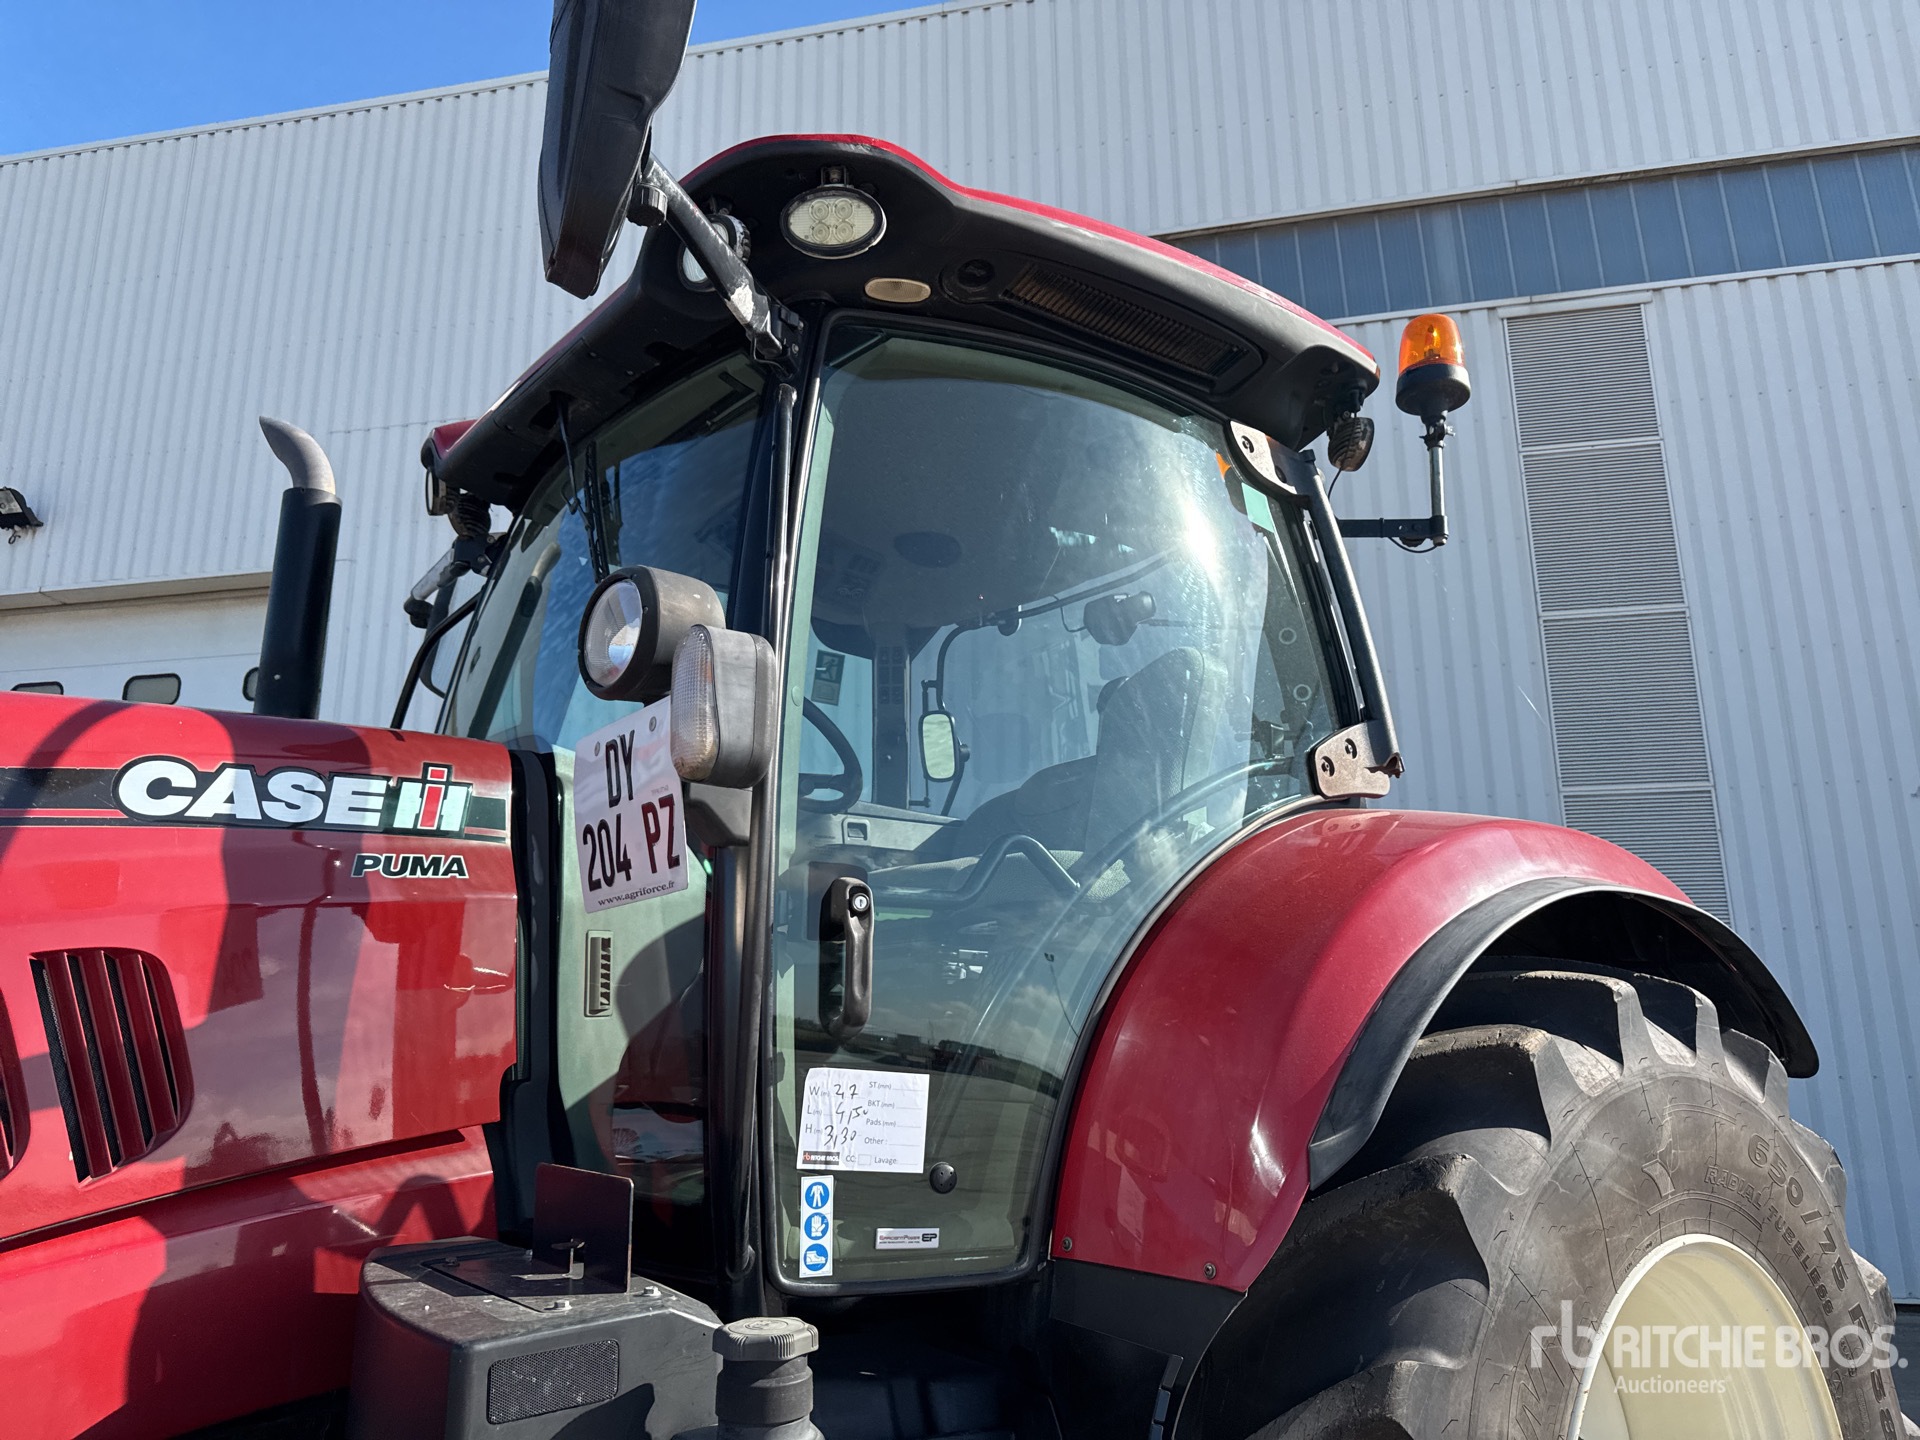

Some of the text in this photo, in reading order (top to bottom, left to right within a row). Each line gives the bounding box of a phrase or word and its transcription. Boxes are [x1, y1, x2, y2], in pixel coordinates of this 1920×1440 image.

[605, 729, 635, 808] DY
[118, 760, 389, 827] CASE
[583, 794, 680, 892] 204 PZ
[351, 854, 470, 878] PUMA
[598, 880, 675, 906] www.agriforce.fr
[809, 1085, 820, 1096] W
[805, 1123, 813, 1134] H
[865, 1118, 882, 1126] Pads
[864, 1136, 884, 1145] Other
[1704, 1165, 1834, 1316] RADIAL TUBELESS
